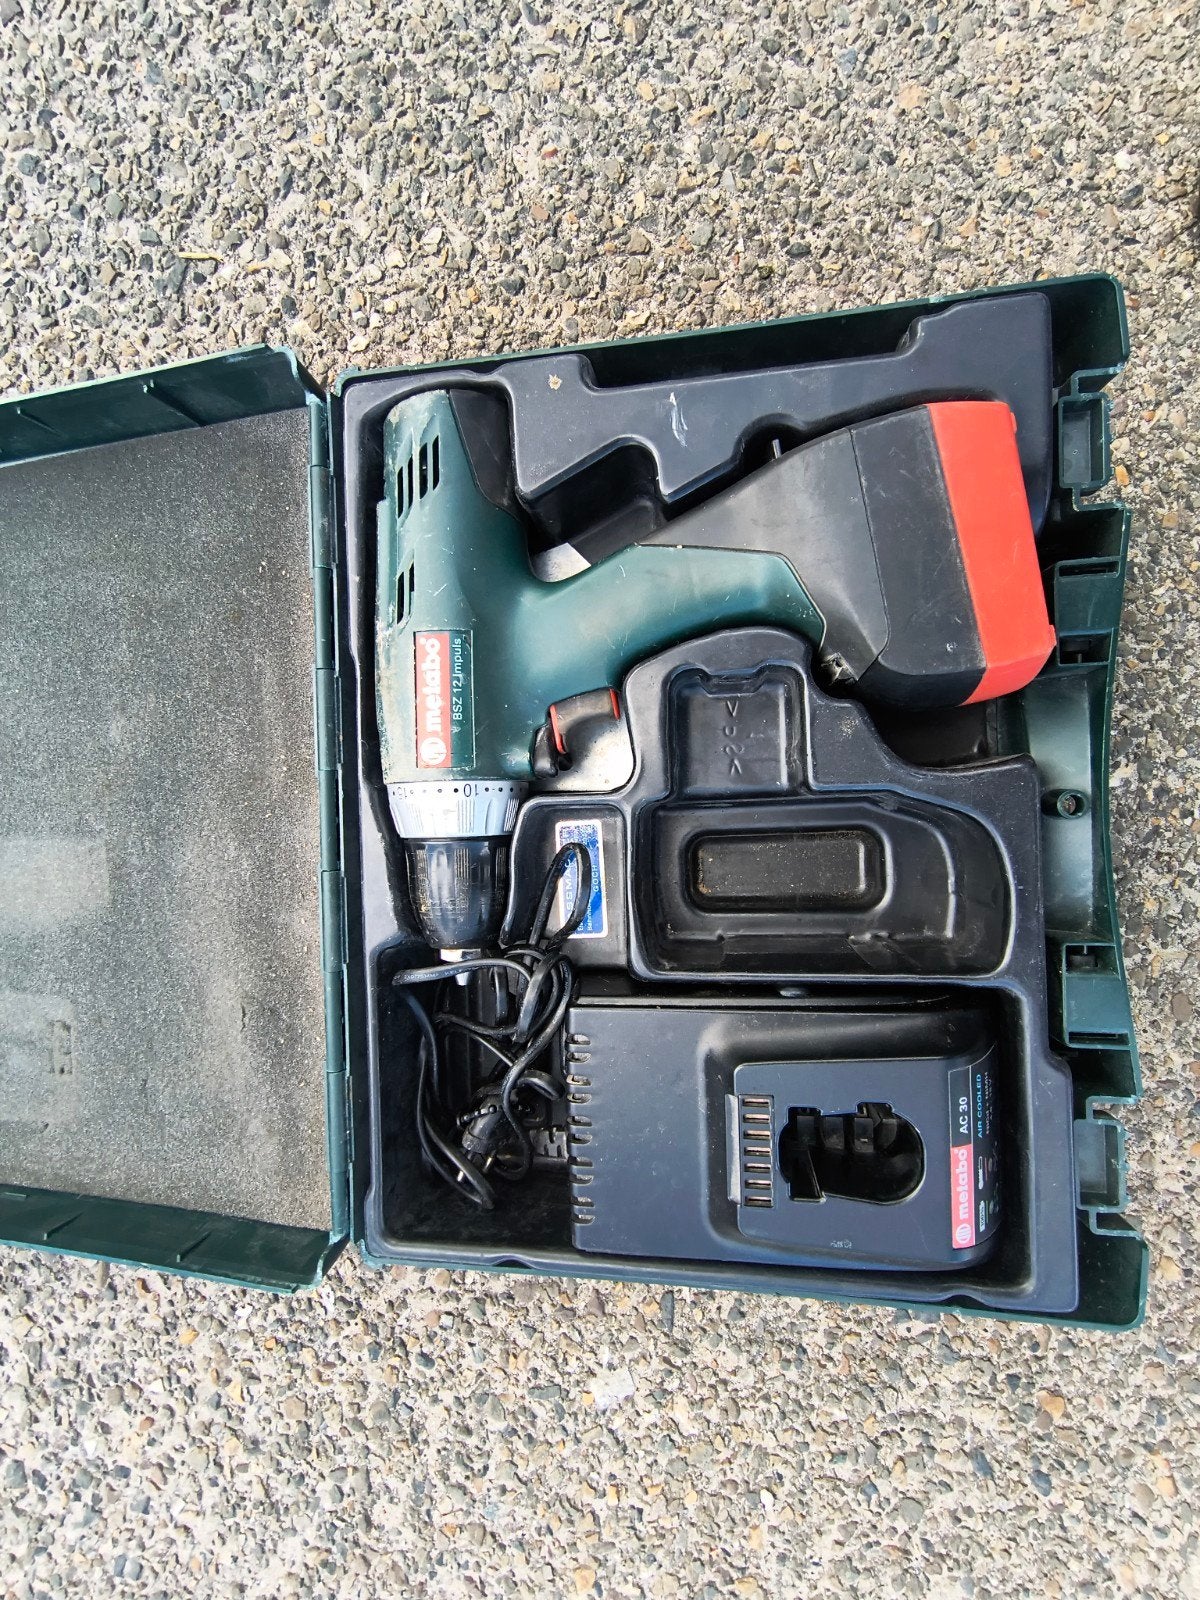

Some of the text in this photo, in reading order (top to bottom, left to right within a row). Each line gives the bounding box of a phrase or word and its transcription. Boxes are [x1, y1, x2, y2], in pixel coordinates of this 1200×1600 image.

[421, 637, 442, 733] metabo
[452, 637, 464, 720] BSZ 12 Impuls
[463, 783, 479, 798] 10
[591, 864, 600, 892] GOCH
[958, 1096, 969, 1134] AC 30
[955, 1148, 969, 1220] metabo
